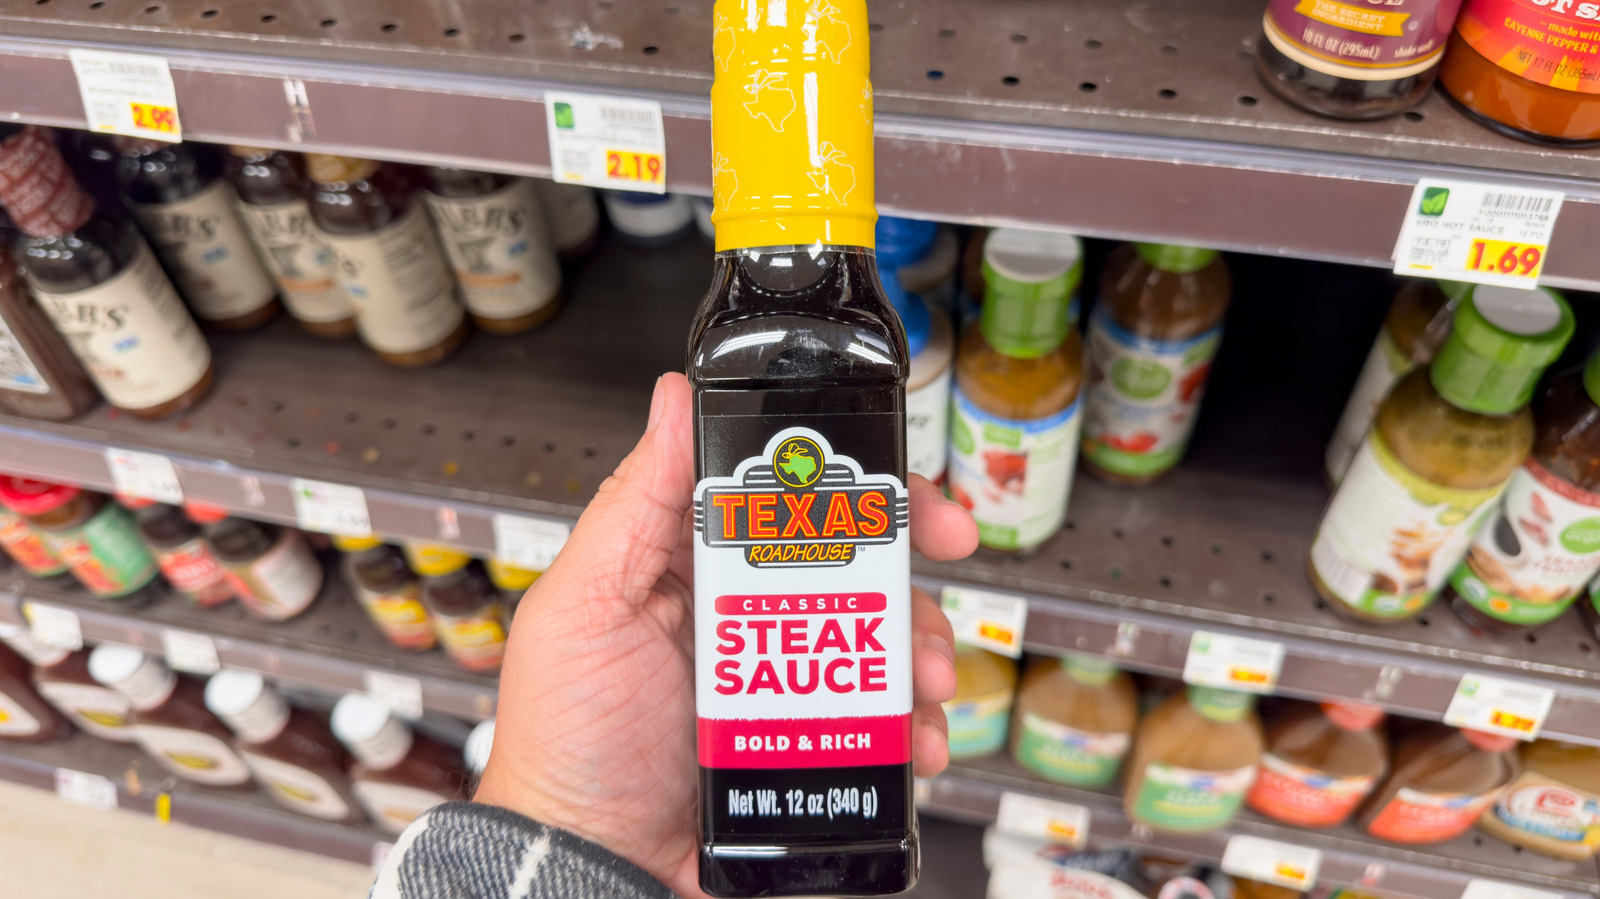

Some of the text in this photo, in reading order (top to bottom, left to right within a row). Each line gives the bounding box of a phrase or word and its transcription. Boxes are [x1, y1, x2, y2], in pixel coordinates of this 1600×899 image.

[1312, 8, 1384, 31] INGREDIENT
[1339, 8, 1386, 24] SECRET
[1303, 28, 1381, 60] 10 FL OZ (295mL)
[1504, 17, 1598, 54] CAYENNE PEPPER &
[1548, 23, 1579, 38] made
[1394, 44, 1418, 58] shake
[1517, 50, 1533, 64] NET
[1554, 63, 1568, 76] OZ
[132, 105, 176, 133] 2.99
[608, 153, 661, 183] 2.19
[1468, 223, 1505, 235] SAUCE
[1473, 242, 1541, 276] 1.69
[713, 491, 889, 539] TEXAS
[749, 544, 854, 562] ROADHOUSE
[743, 597, 858, 611] CLASSIC
[715, 617, 887, 656] STEAK
[714, 657, 888, 696] SAUCE
[734, 733, 871, 751] BOLD & RICH
[728, 786, 878, 821] Net Wt. 12 oz (340 g)
